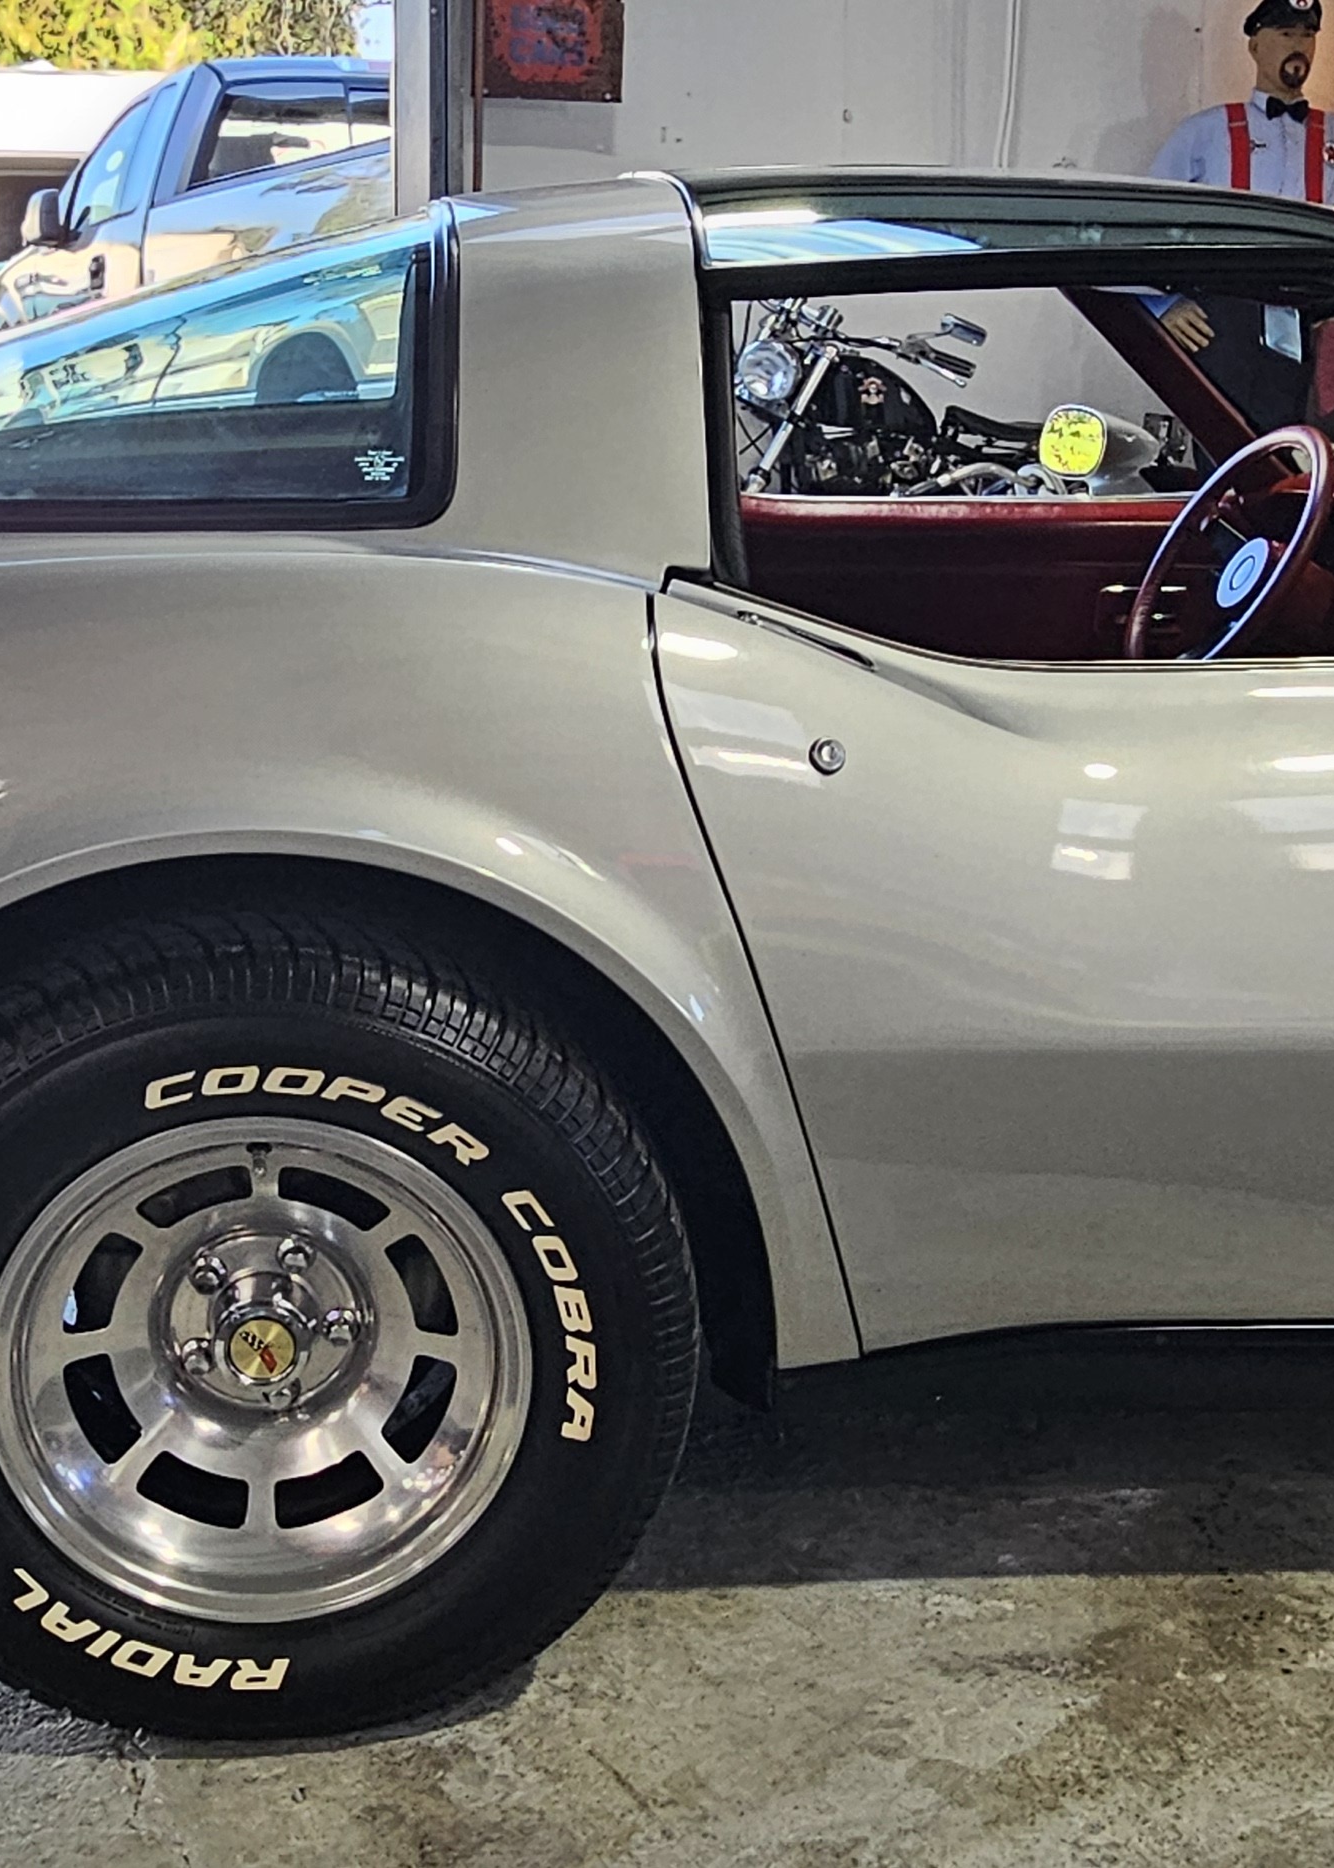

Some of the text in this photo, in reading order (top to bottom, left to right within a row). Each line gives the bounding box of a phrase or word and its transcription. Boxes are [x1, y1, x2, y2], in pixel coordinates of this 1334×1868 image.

[143, 1064, 597, 1443] COOPER COBRA
[12, 1567, 290, 1692] RADIAL
